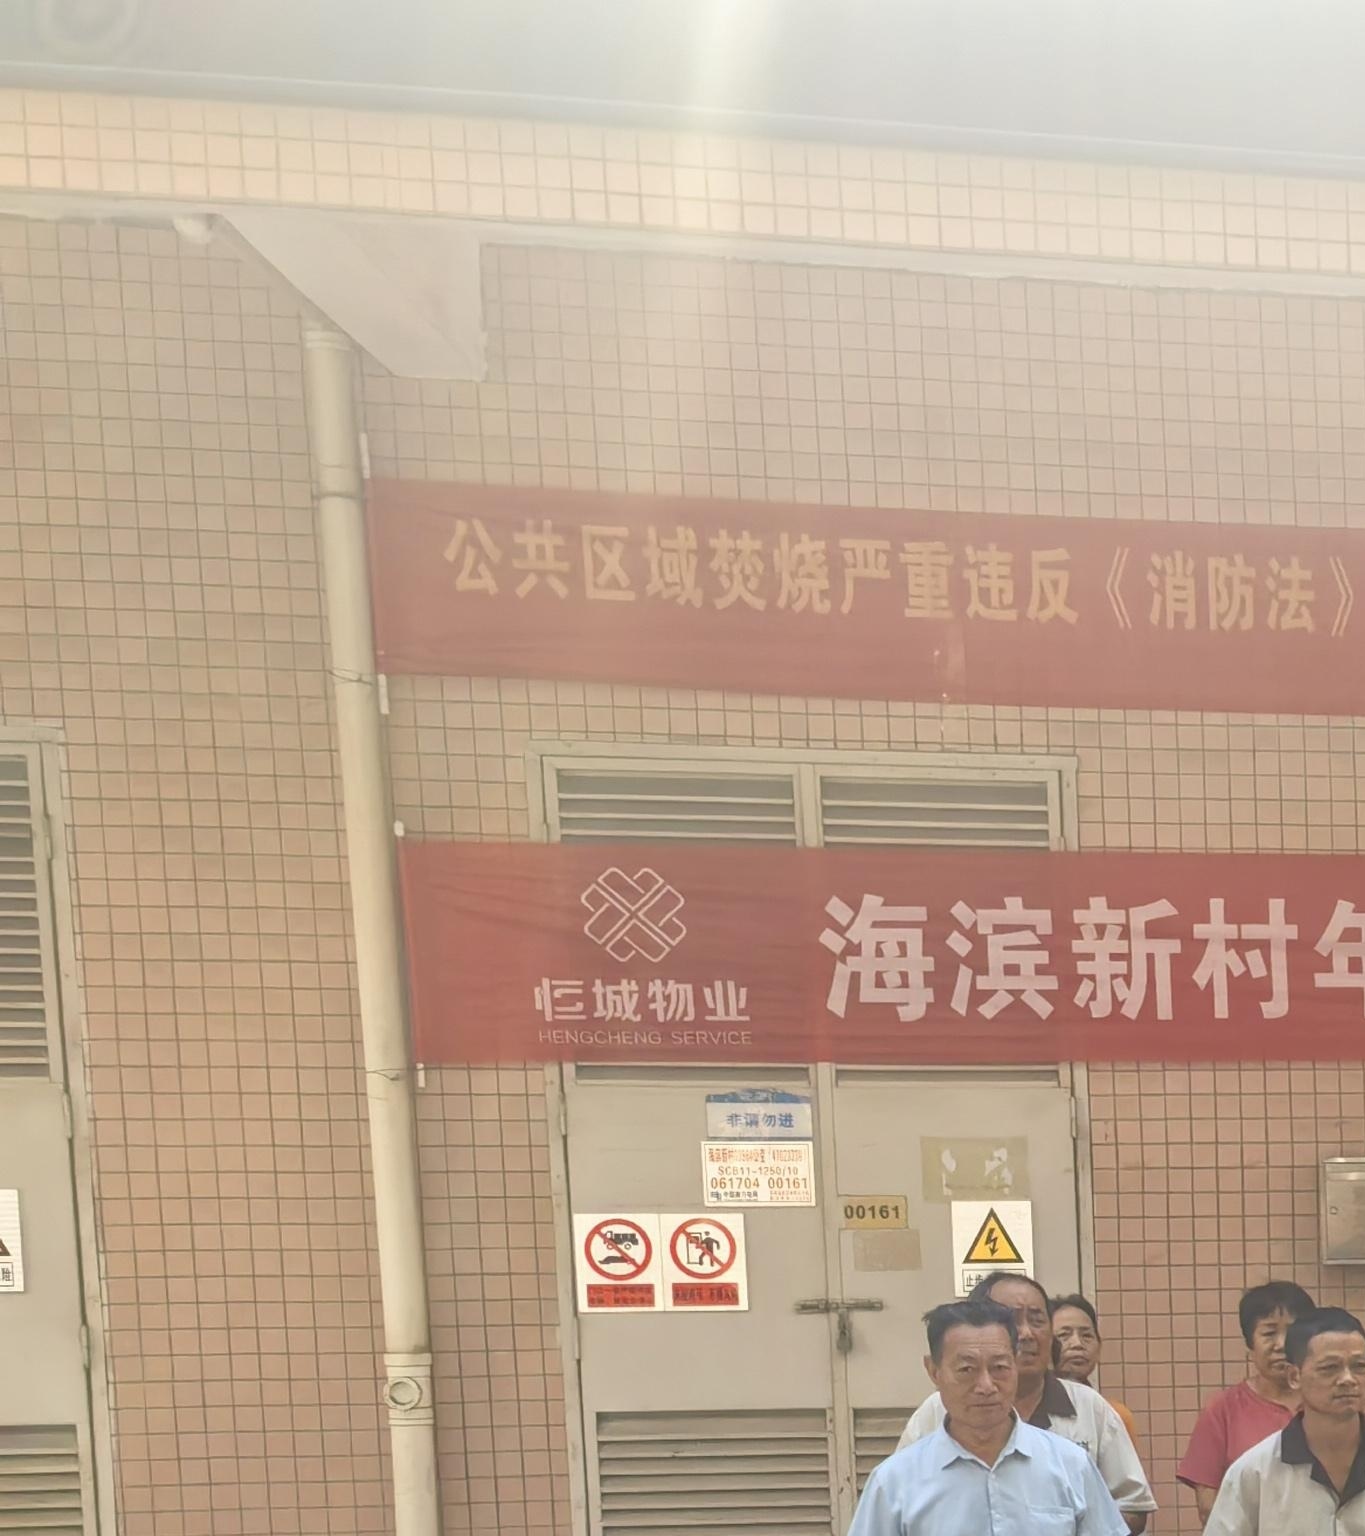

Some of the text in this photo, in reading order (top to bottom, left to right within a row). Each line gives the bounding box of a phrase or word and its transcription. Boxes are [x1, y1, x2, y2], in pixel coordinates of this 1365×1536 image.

[534, 977, 750, 1022] 恒城物业
[538, 1029, 752, 1045] HENGCHENG SERVICE
[727, 1113, 794, 1128] 非请勿进
[710, 1177, 809, 1190] 061704 00161
[844, 1204, 900, 1220] 00161
